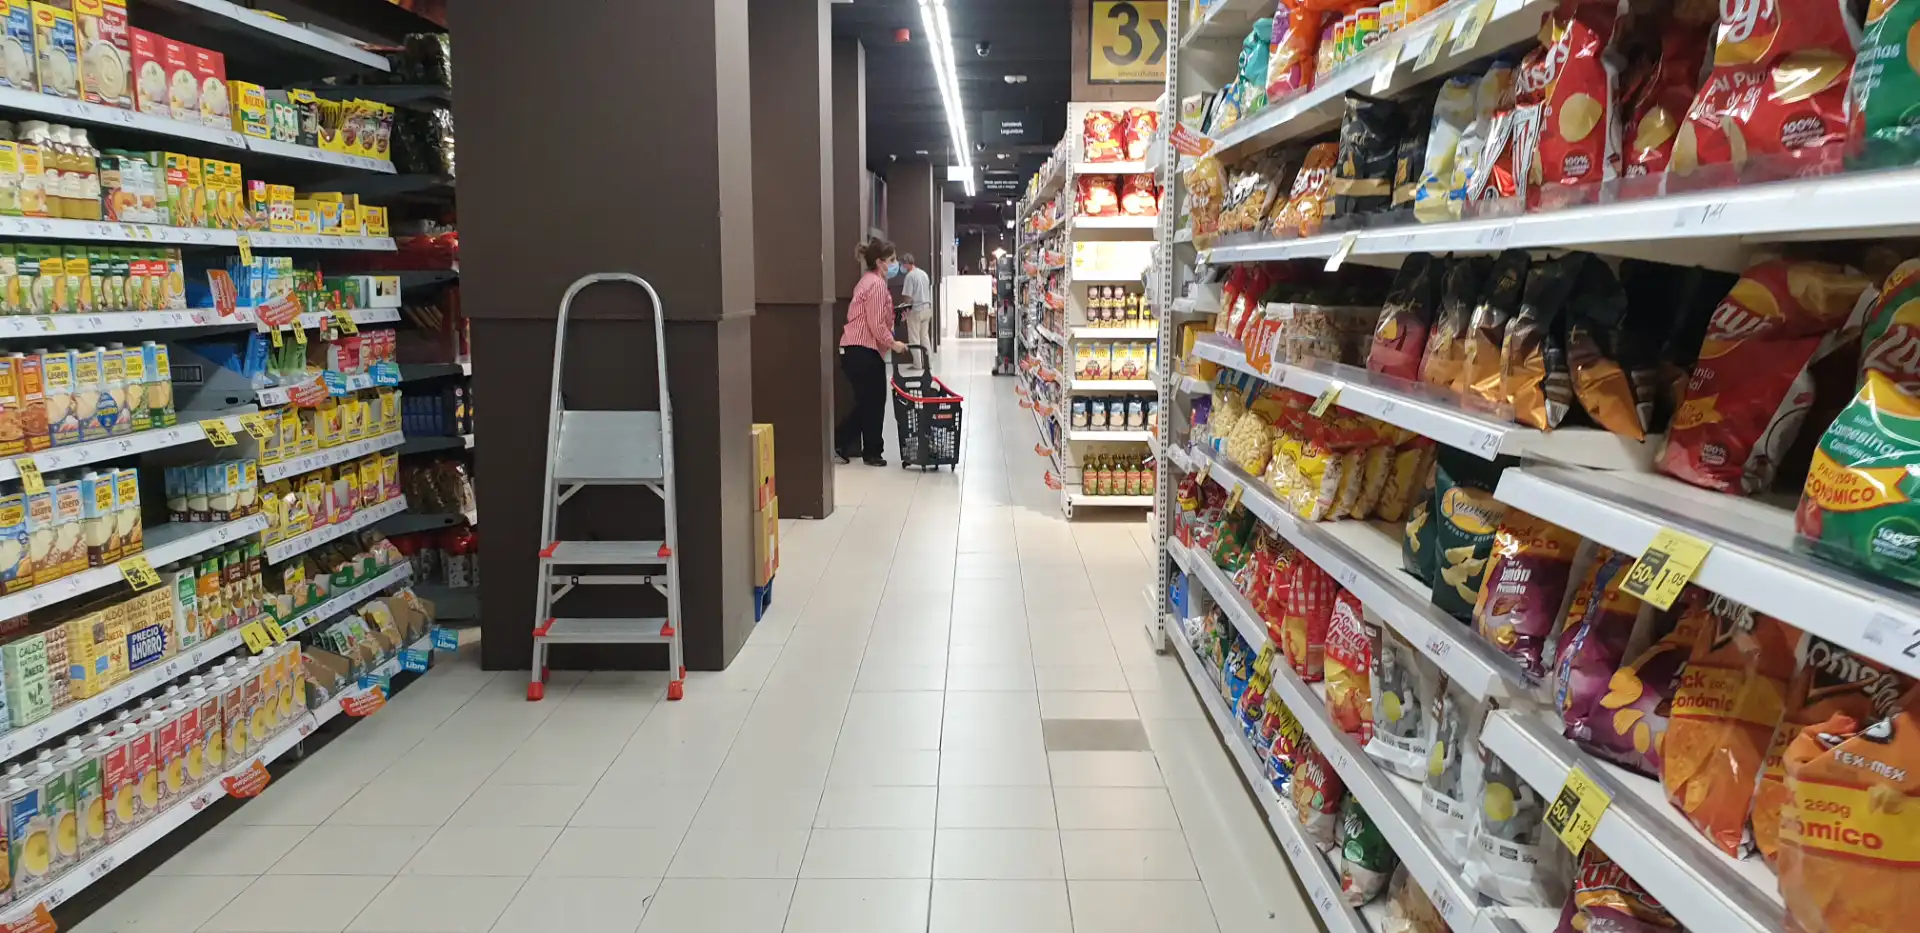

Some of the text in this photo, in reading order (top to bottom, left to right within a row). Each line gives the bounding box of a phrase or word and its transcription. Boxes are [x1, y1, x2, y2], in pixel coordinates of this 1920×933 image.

[1711, 74, 1731, 93] Al
[1783, 118, 1821, 133] 100%
[1564, 155, 1589, 167] 100%
[377, 375, 396, 384] Libre
[1703, 444, 1726, 457] 100%
[1500, 564, 1532, 582] Jamón
[132, 626, 160, 641] PRECIO
[131, 635, 162, 662] AHORRO
[437, 639, 456, 649] Libre
[405, 661, 426, 670] Libre
